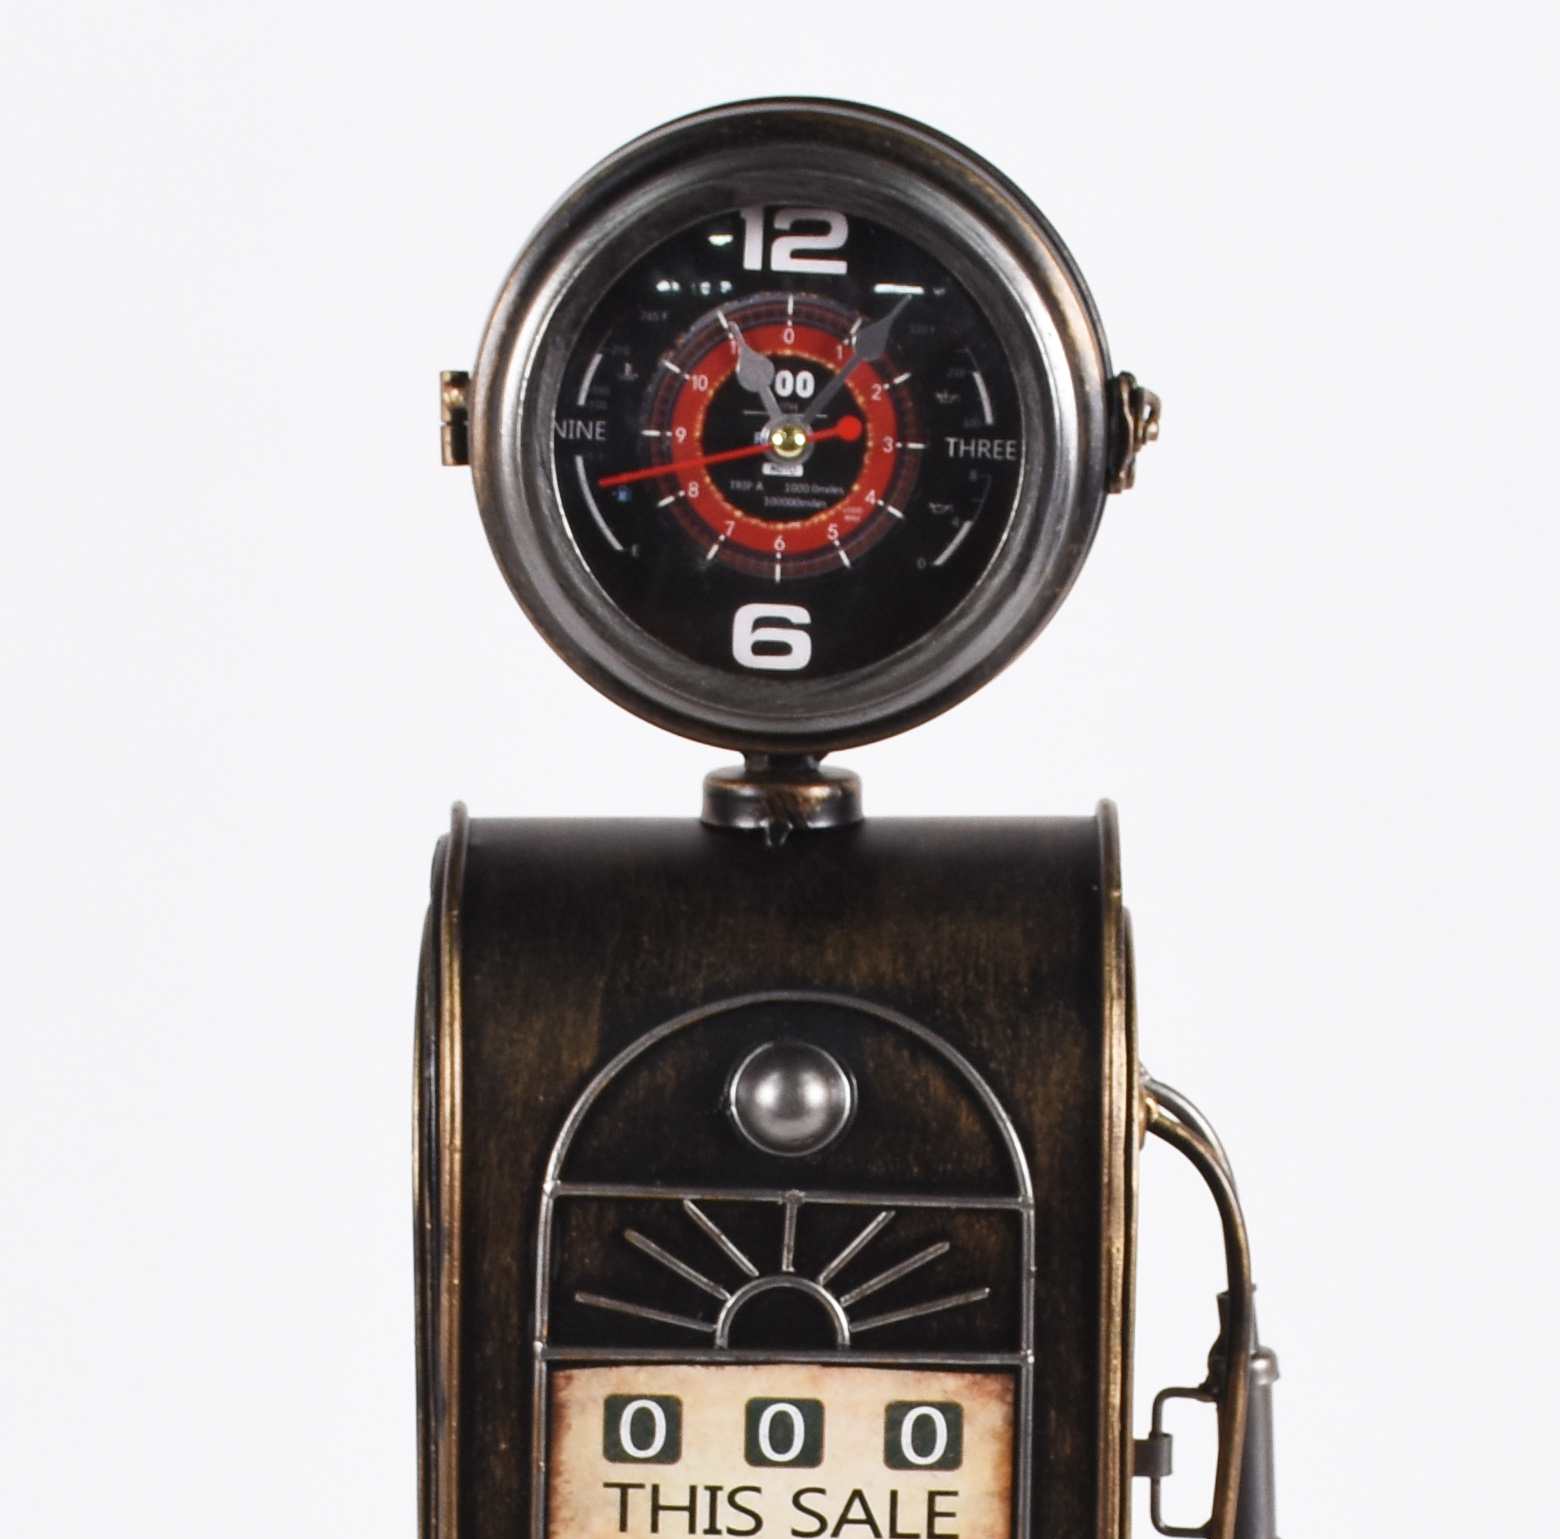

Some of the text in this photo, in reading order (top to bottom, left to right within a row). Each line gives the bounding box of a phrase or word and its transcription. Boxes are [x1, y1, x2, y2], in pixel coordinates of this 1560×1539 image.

[740, 204, 848, 275] 12
[783, 328, 795, 344] 0
[691, 375, 708, 391] 10
[872, 385, 882, 400] 2
[554, 419, 606, 439] NINE
[675, 427, 687, 441] 9
[883, 438, 893, 452] 3
[945, 438, 1017, 461] THREE
[688, 482, 699, 497] 8
[865, 489, 876, 505] 4
[725, 521, 735, 537] 7
[827, 523, 838, 539] 5
[774, 535, 785, 551] 6
[732, 603, 812, 671] 6
[620, 1400, 948, 1466] 0 0 0
[602, 1482, 764, 1537] THIS
